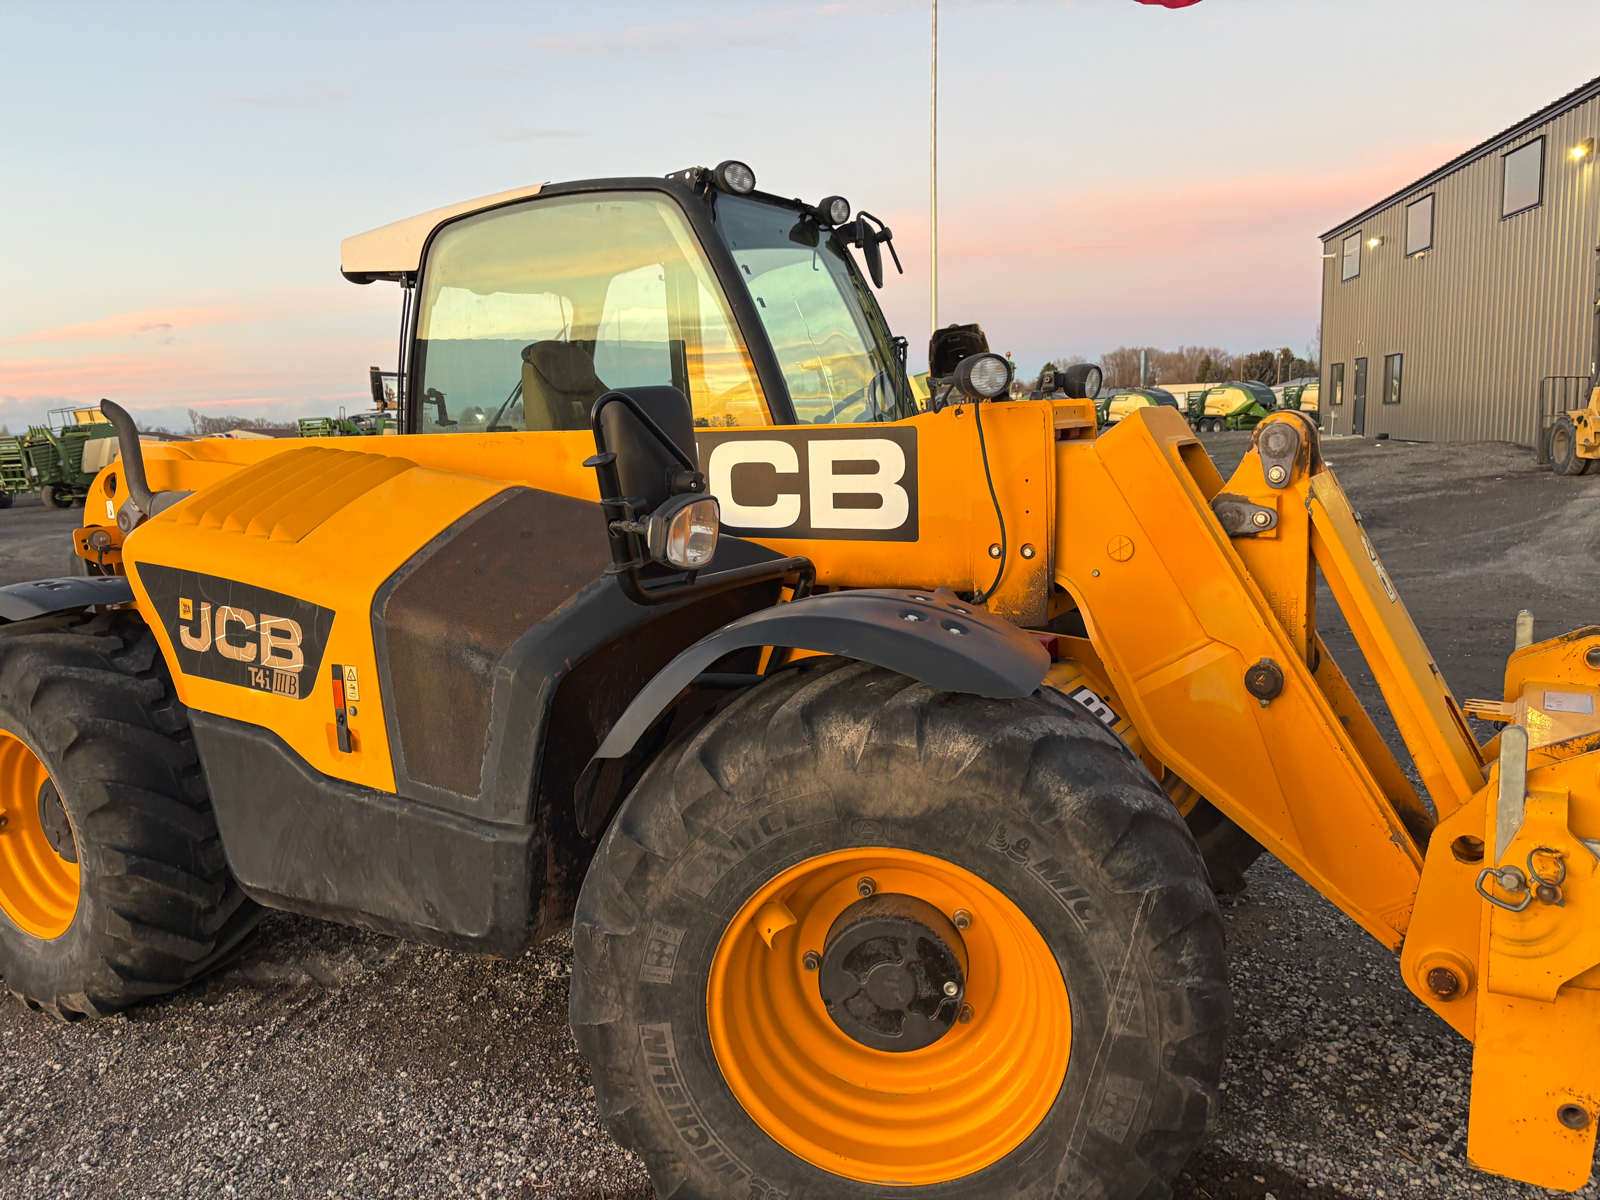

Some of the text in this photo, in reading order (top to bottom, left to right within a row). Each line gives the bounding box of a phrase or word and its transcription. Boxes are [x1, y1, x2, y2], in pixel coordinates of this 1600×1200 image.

[695, 438, 909, 530] CB
[179, 601, 304, 673] JCB
[248, 666, 271, 690] T4i
[640, 1025, 749, 1183] MICHELIN
